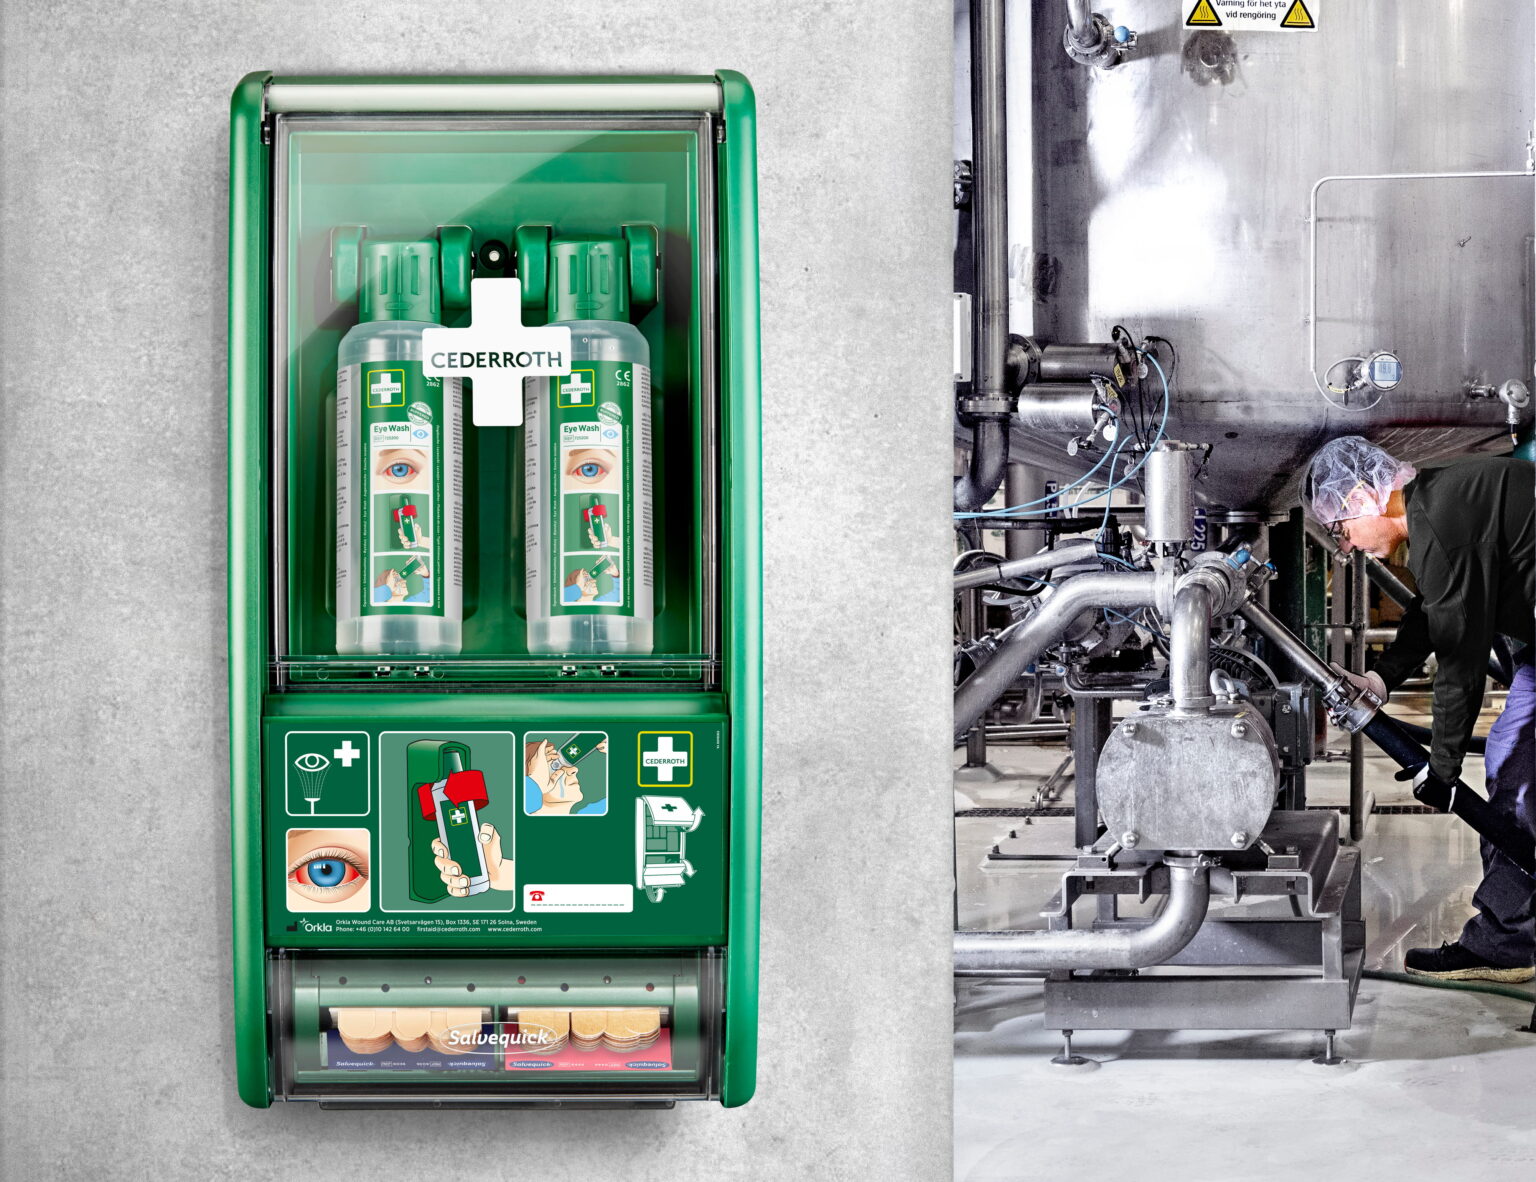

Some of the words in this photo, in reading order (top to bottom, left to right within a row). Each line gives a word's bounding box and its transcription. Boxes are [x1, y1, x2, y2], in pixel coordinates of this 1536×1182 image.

[1275, 0, 1287, 9] yta
[1240, 11, 1277, 21] rengöring
[431, 351, 563, 369] CEDERROTH
[374, 425, 387, 434] Eye
[388, 424, 410, 432] Wash
[564, 426, 577, 434] Eye
[578, 424, 600, 432] Wash
[304, 922, 333, 933] Orkla
[448, 1029, 550, 1049] Salvequick
